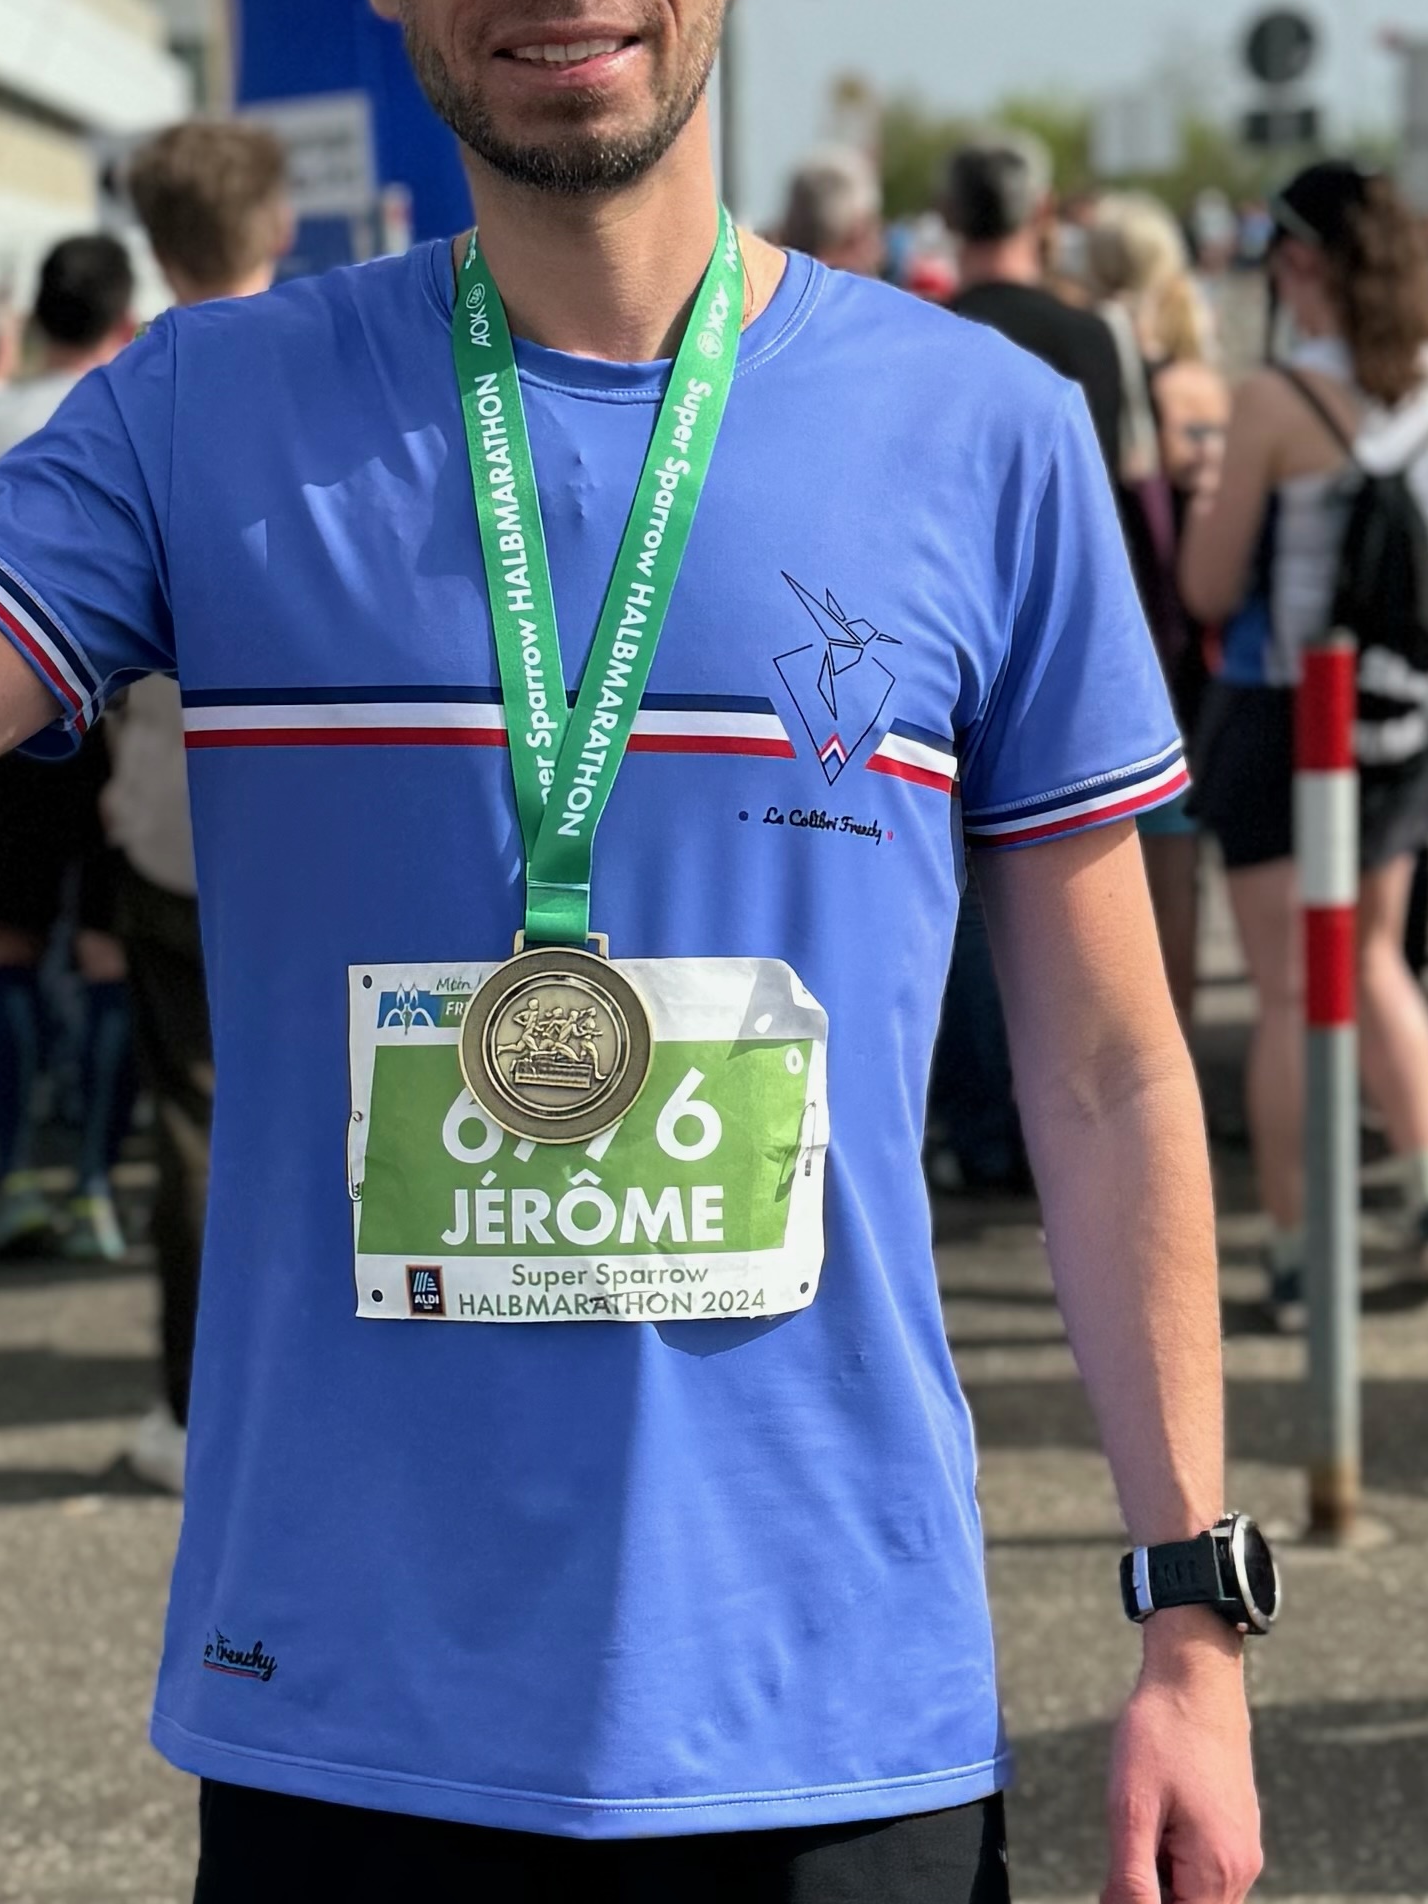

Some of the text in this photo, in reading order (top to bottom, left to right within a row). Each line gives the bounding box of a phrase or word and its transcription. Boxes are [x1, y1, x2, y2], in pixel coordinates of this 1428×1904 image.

[469, 304, 492, 347] AOK
[474, 372, 534, 612] HALBMARATHON
[557, 377, 713, 837] Super Sparrow HALBMARATHON
[518, 617, 558, 748] Sparrow
[442, 1066, 723, 1164] 66
[440, 1168, 725, 1246] JÉRÔME
[414, 1294, 440, 1305] ALDI
[459, 1288, 767, 1317] HALBMARATHON 2024
[511, 1262, 709, 1292] Super Sparrow
